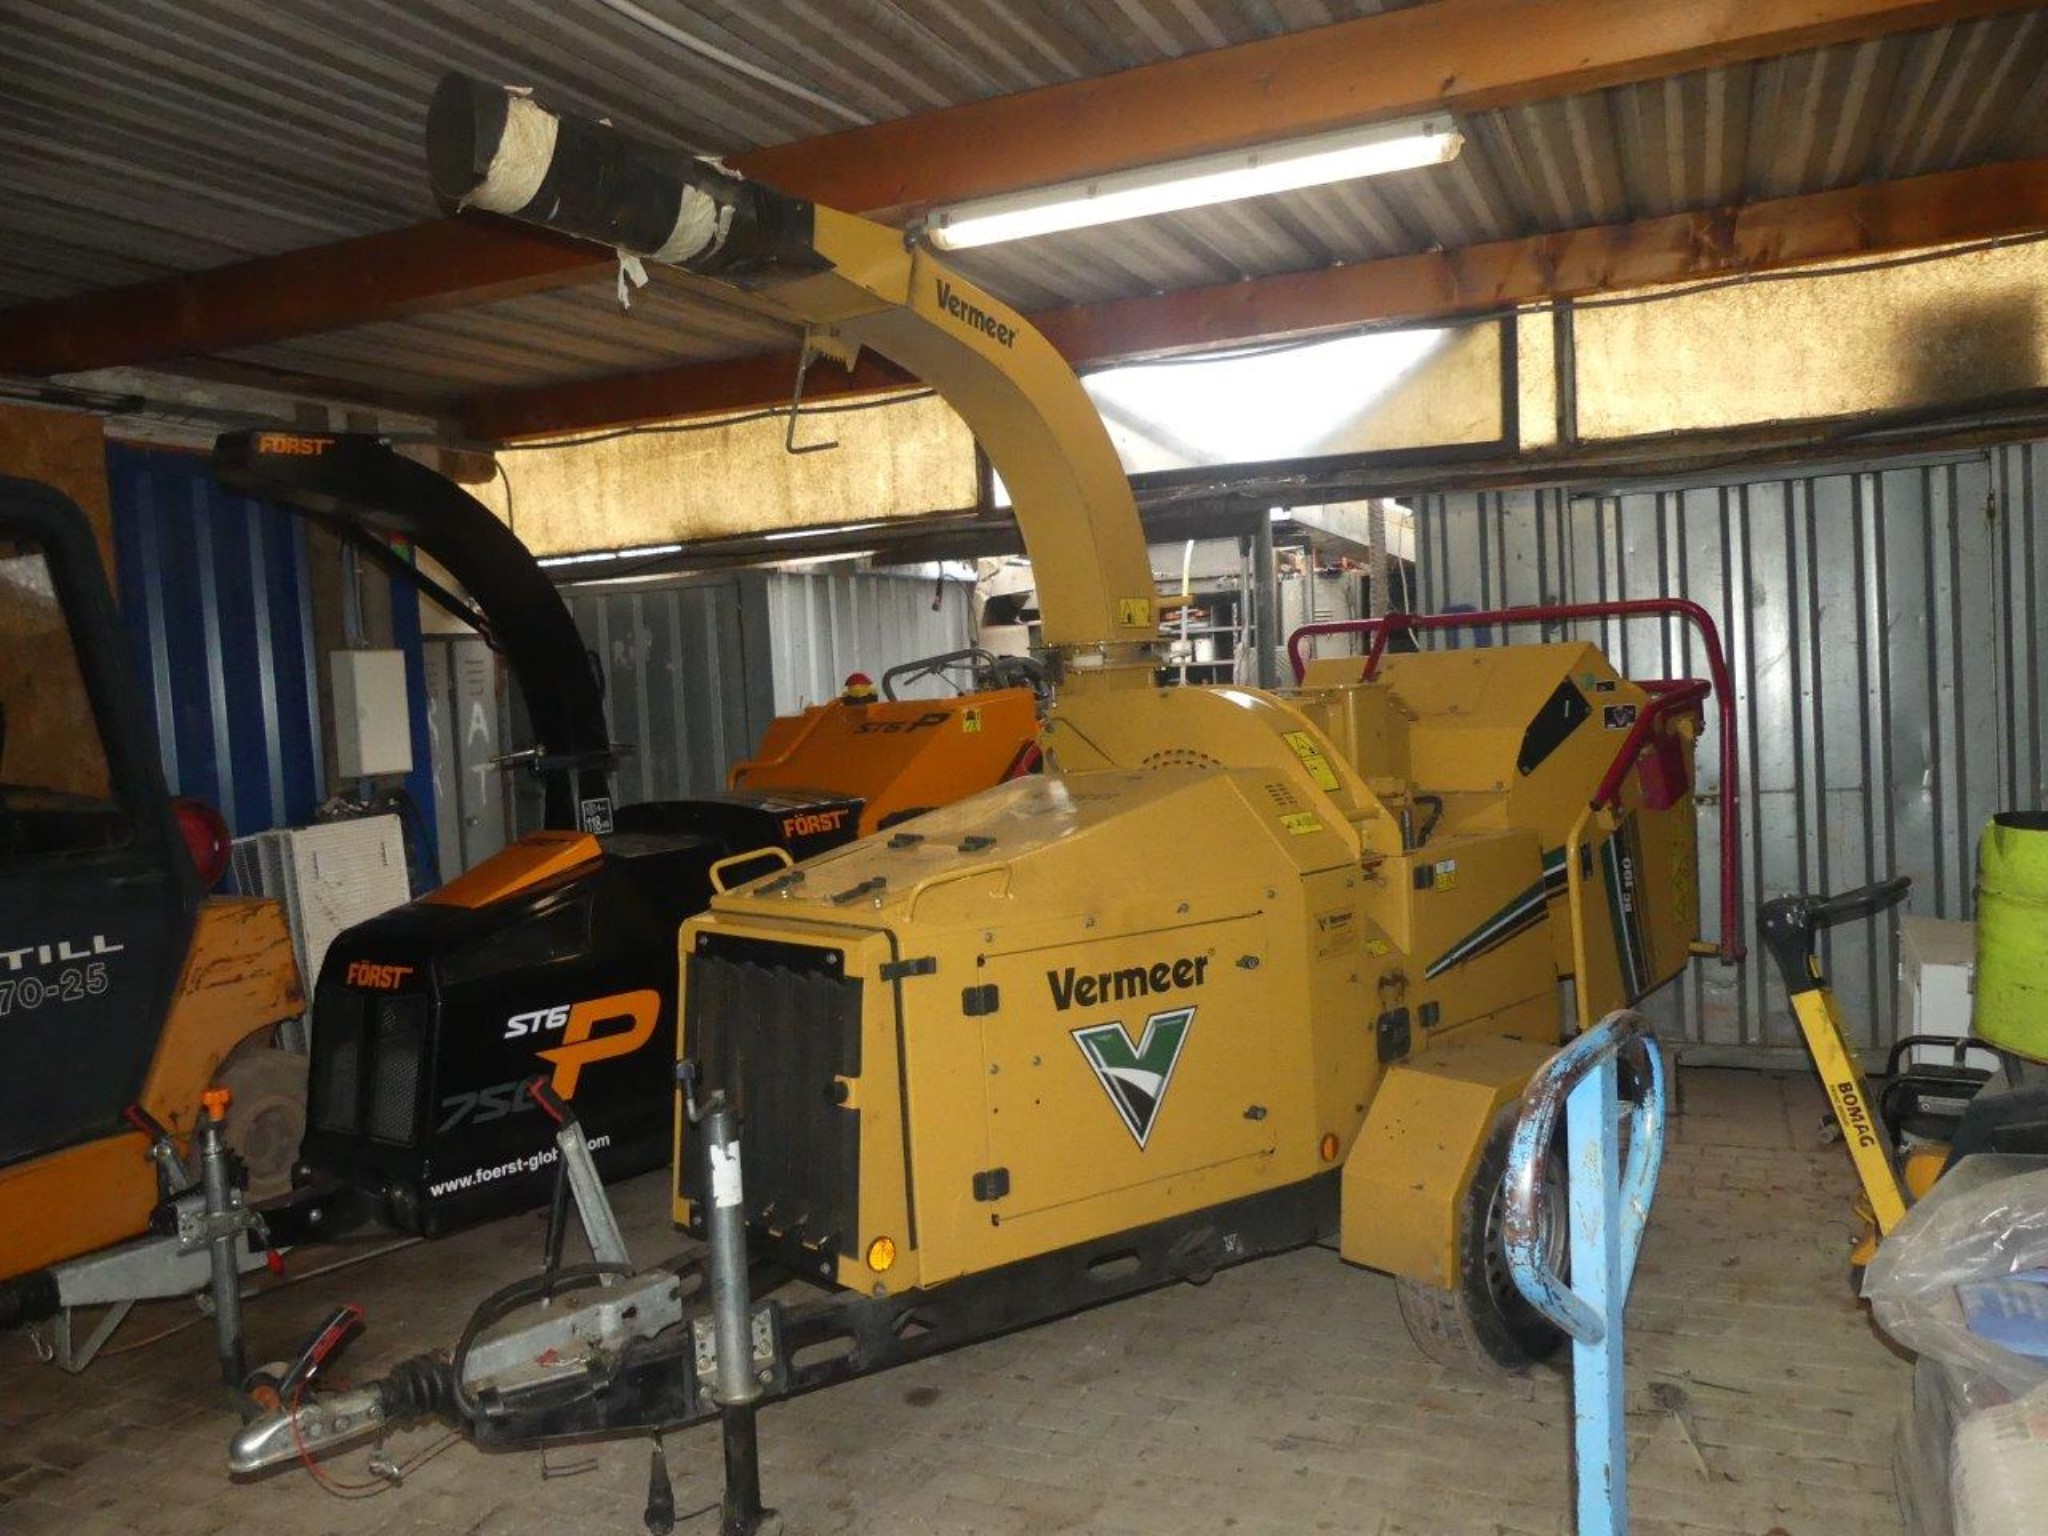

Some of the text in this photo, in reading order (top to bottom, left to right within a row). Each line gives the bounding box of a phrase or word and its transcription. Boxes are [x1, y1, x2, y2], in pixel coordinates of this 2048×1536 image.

[936, 279, 1016, 349] Vermeer
[783, 807, 849, 838] FÖRST
[346, 960, 414, 990] FÖRST
[1047, 955, 1209, 1012] Vermeer
[1837, 1081, 1876, 1148] BOMAG
